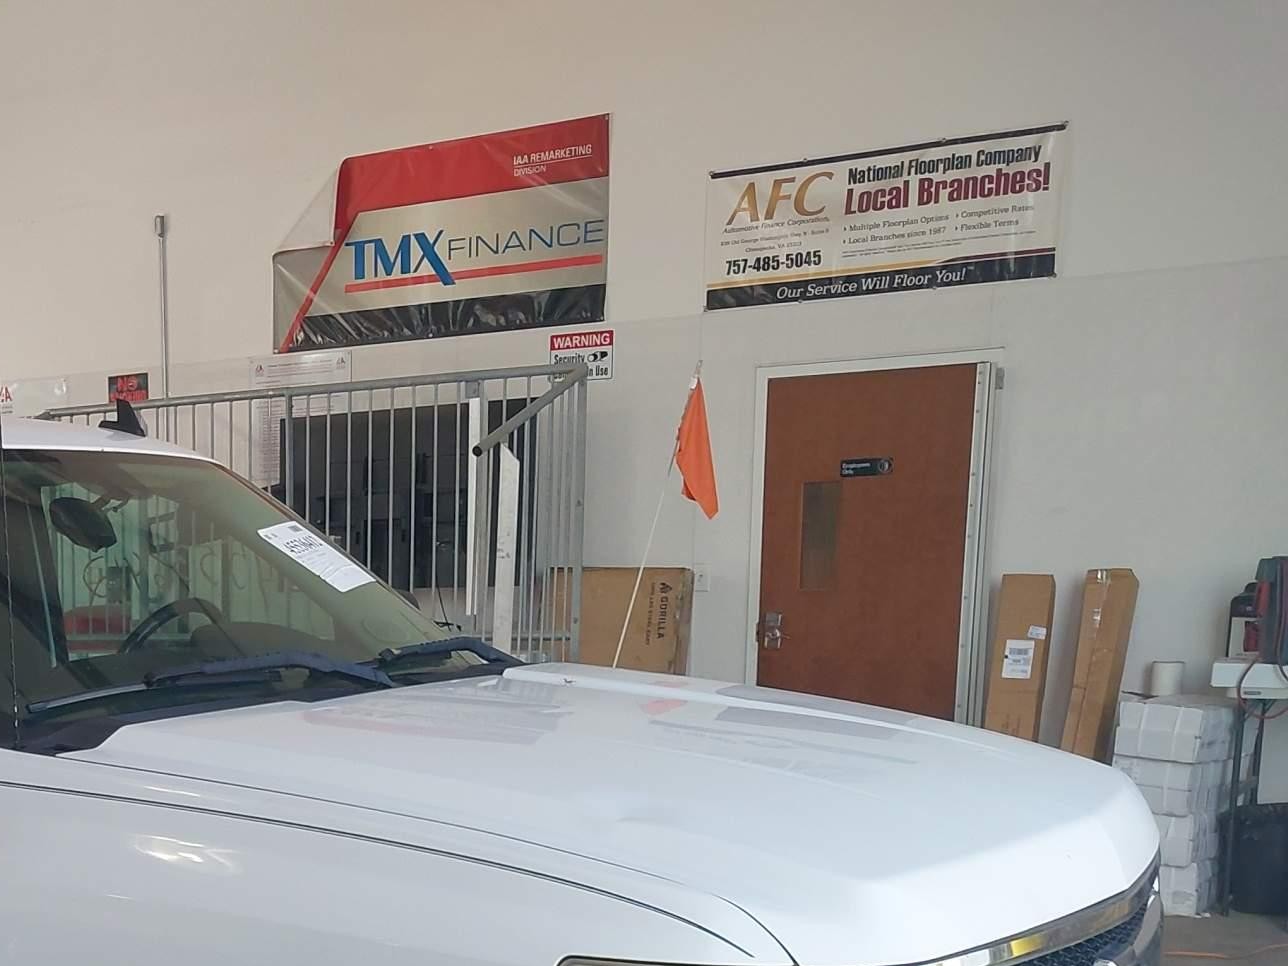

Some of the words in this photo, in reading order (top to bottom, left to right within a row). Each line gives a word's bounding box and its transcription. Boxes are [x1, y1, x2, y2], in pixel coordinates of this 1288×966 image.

[513, 154, 529, 165] IAA
[530, 144, 593, 163] REMARKETING
[848, 159, 904, 186] National
[907, 153, 972, 177] Floorplan
[976, 144, 1042, 168] Company
[513, 164, 547, 177] DIVISION
[725, 171, 834, 226] AFC
[844, 182, 909, 216] Local
[917, 162, 1050, 208] Branches!
[850, 221, 880, 234] Multiple
[882, 216, 918, 230] Floorplan
[920, 212, 949, 225] Options
[961, 205, 1009, 220] Competitive
[960, 221, 991, 232] Flexible
[994, 217, 1019, 228] Terms
[848, 235, 868, 245] Local
[870, 230, 905, 243] Branches
[344, 229, 457, 286] TMX
[448, 218, 605, 261] FINANCE
[725, 249, 823, 276] 757-485-5045
[777, 285, 803, 299] Our
[807, 279, 858, 296] Service
[861, 275, 890, 291] Will
[894, 271, 932, 287] Floor
[553, 333, 611, 349] WARNING
[595, 365, 609, 377] Use
[117, 375, 137, 391] NO
[656, 596, 669, 639] GORILLA
